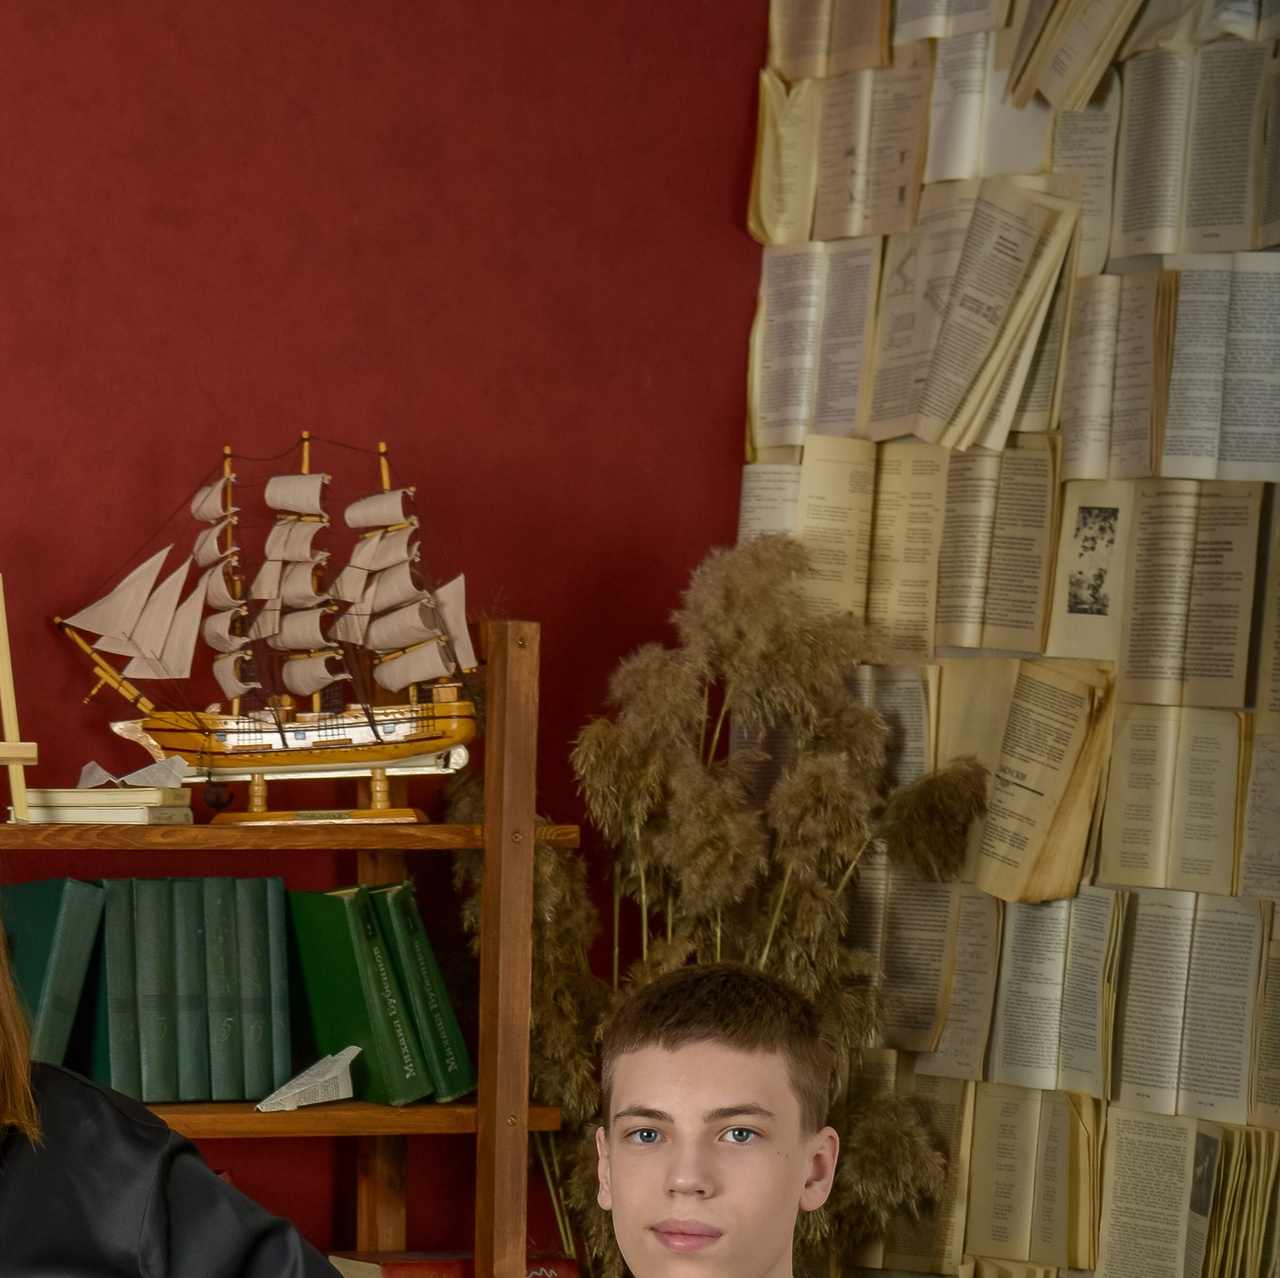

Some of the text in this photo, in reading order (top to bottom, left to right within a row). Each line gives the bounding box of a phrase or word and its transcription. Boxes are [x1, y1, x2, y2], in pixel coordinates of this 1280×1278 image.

[371, 945, 399, 1017] Бубеннов
[215, 1017, 235, 1042] 5
[392, 1019, 418, 1079] Михаил
[432, 1012, 459, 1073] Михаил
